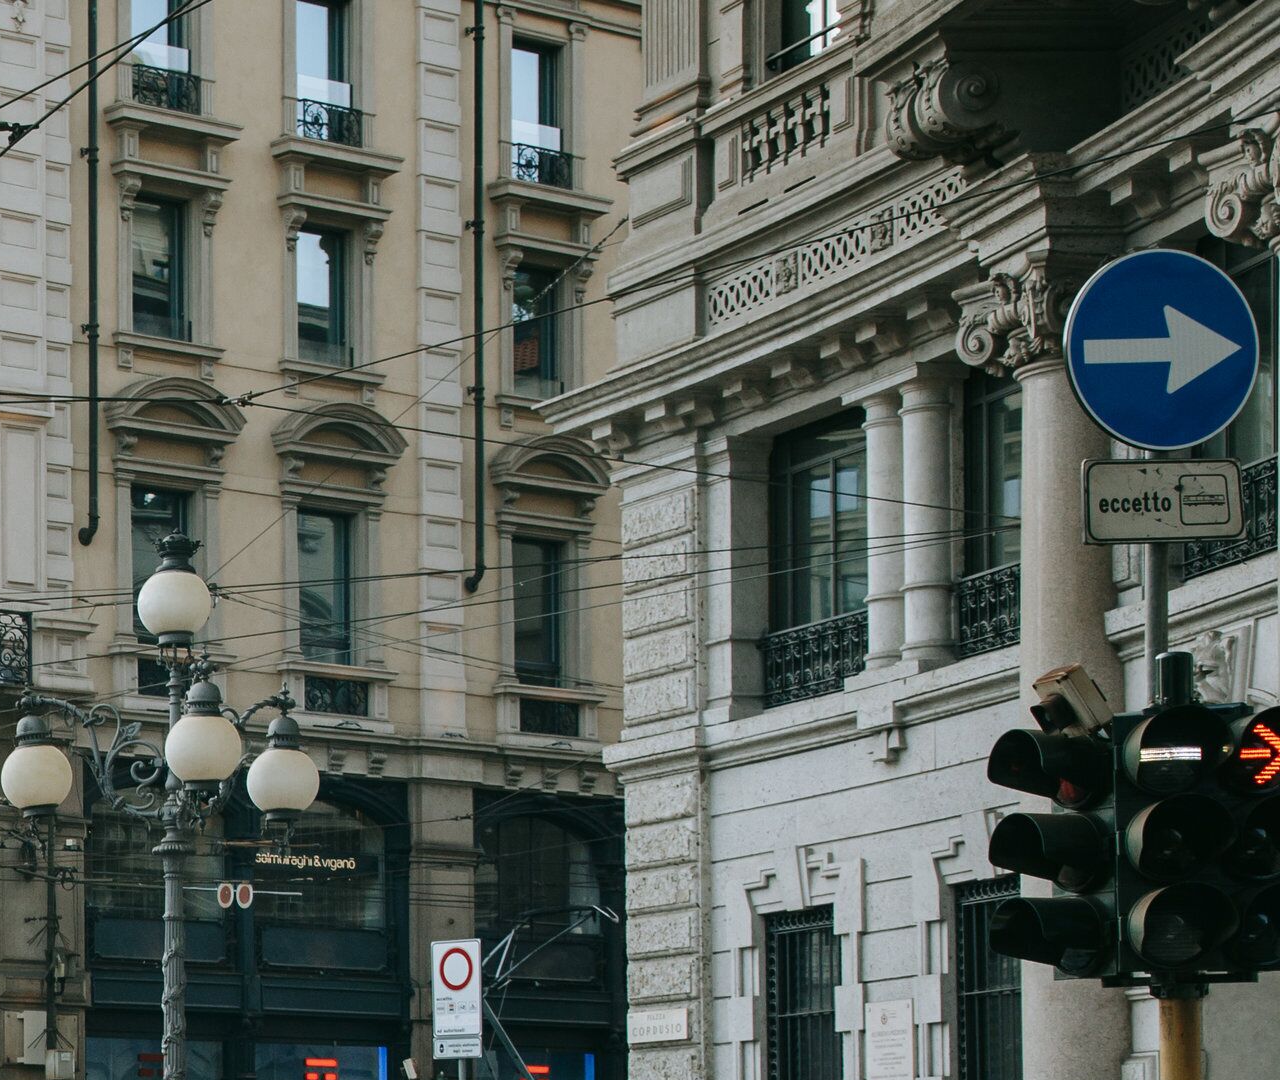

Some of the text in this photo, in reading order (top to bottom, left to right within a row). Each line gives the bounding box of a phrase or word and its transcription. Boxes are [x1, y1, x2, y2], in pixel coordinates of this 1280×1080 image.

[1099, 491, 1172, 513] eccetto
[313, 855, 321, 867] &
[632, 1023, 682, 1037] CORDUSIO
